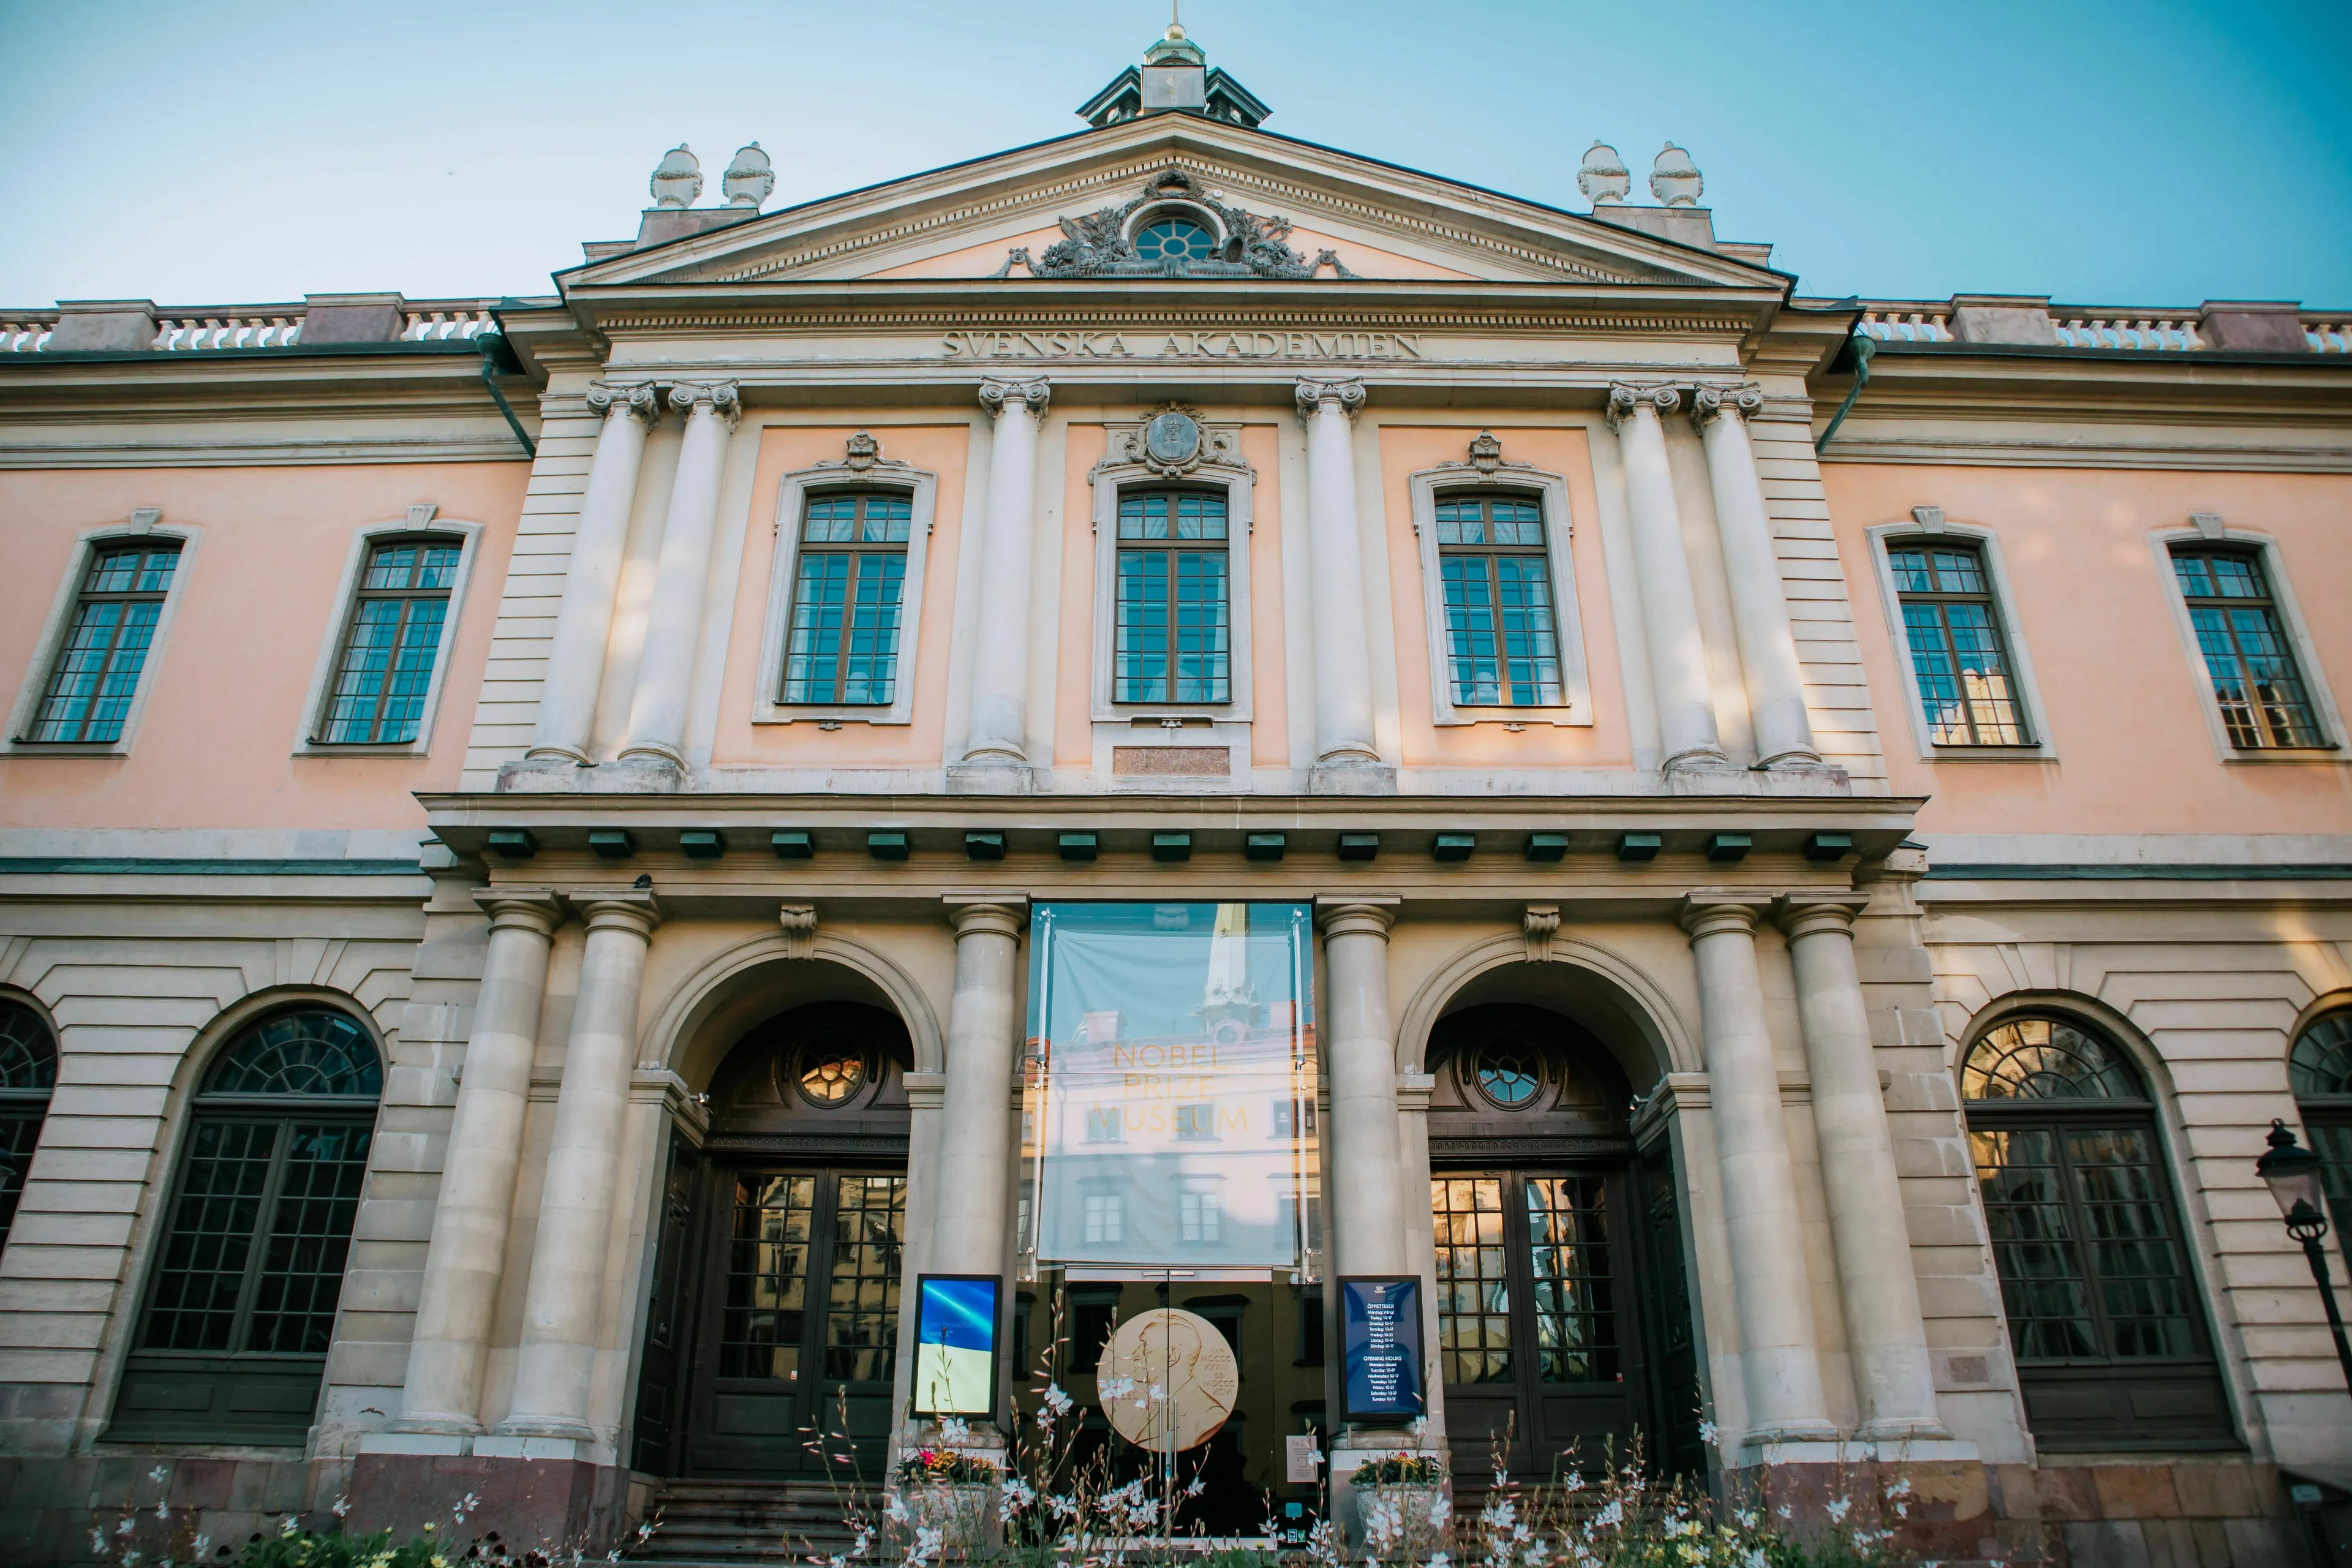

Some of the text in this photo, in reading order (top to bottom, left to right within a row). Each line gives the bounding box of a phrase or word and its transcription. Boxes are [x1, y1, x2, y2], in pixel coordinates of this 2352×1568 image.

[943, 331, 1422, 357] SVENSKA AKADEMIEN
[1114, 1042, 1227, 1070] NOBEL
[1125, 1074, 1216, 1101] PRIZE
[1088, 1102, 1249, 1132] MUSEUM
